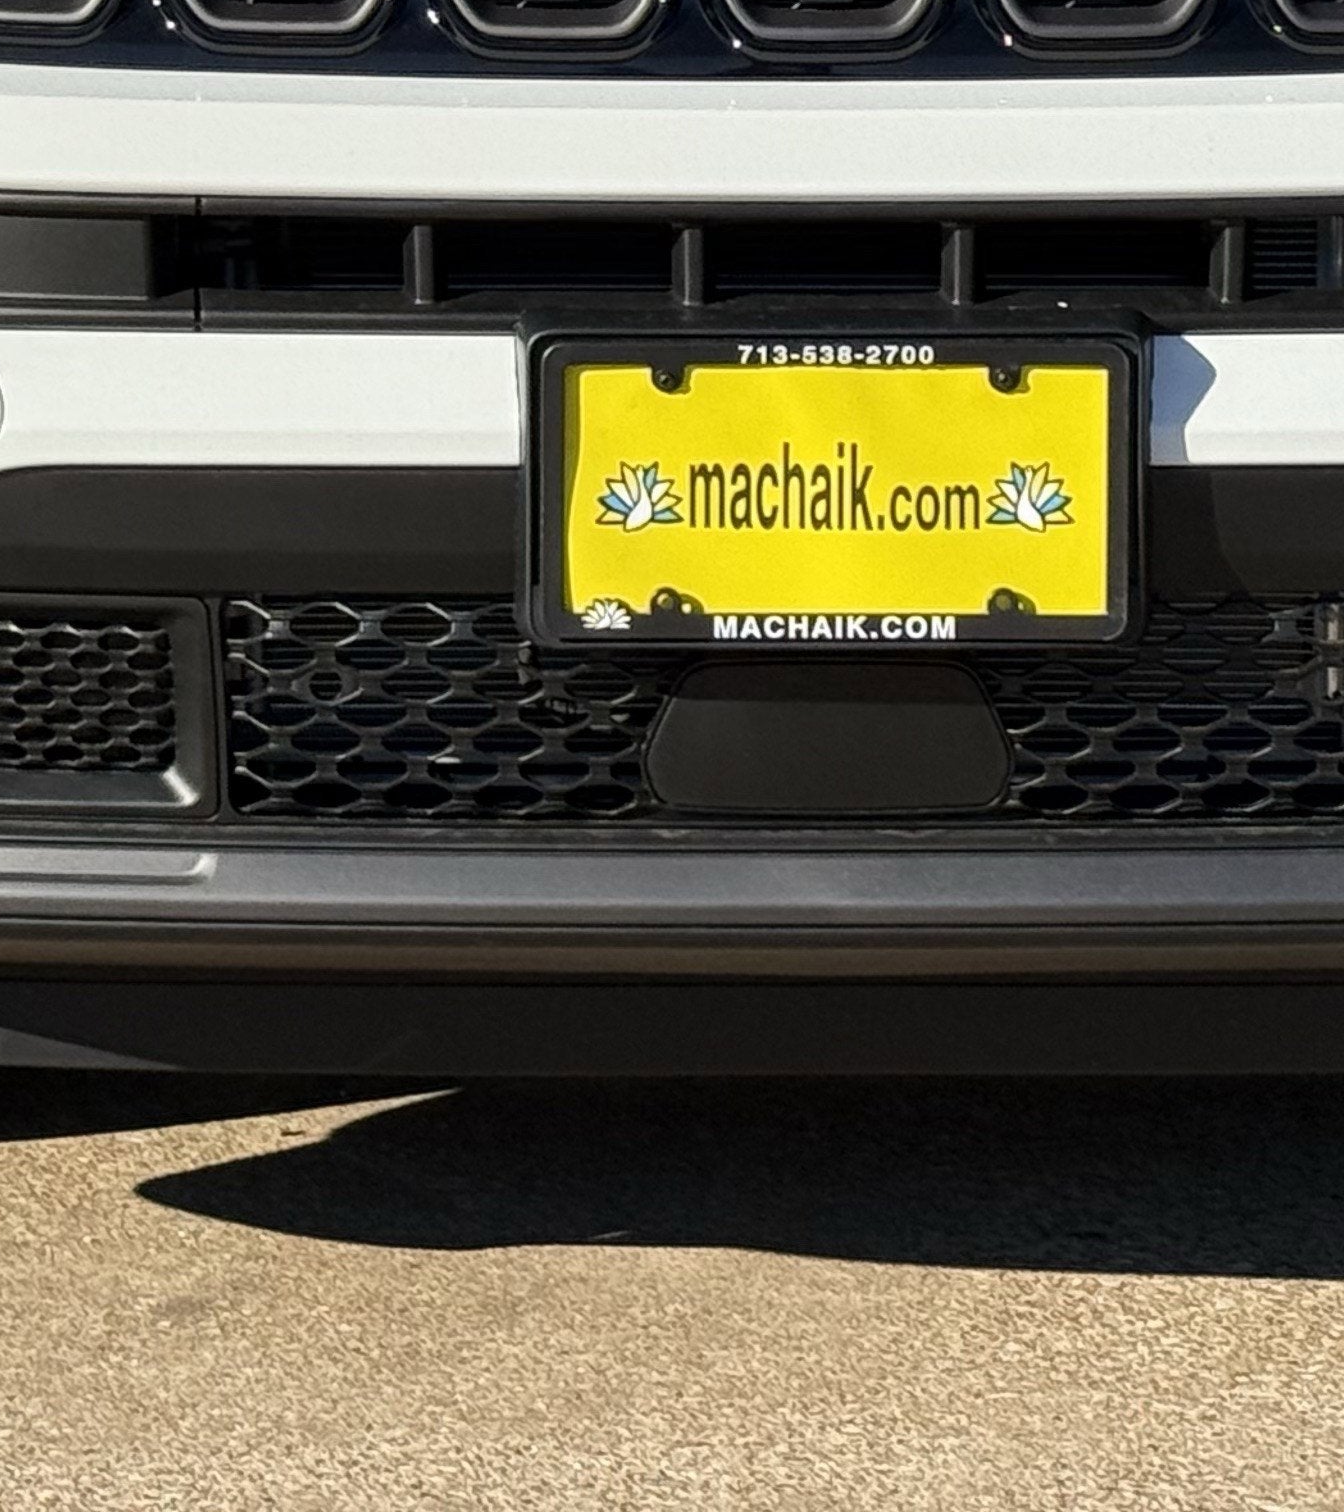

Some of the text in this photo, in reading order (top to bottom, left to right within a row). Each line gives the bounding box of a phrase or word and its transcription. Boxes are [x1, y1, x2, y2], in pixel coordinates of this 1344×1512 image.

[738, 344, 935, 365] 713-538-2700
[689, 441, 981, 531] machaik.com
[713, 615, 957, 639] MACHAIK.COM
